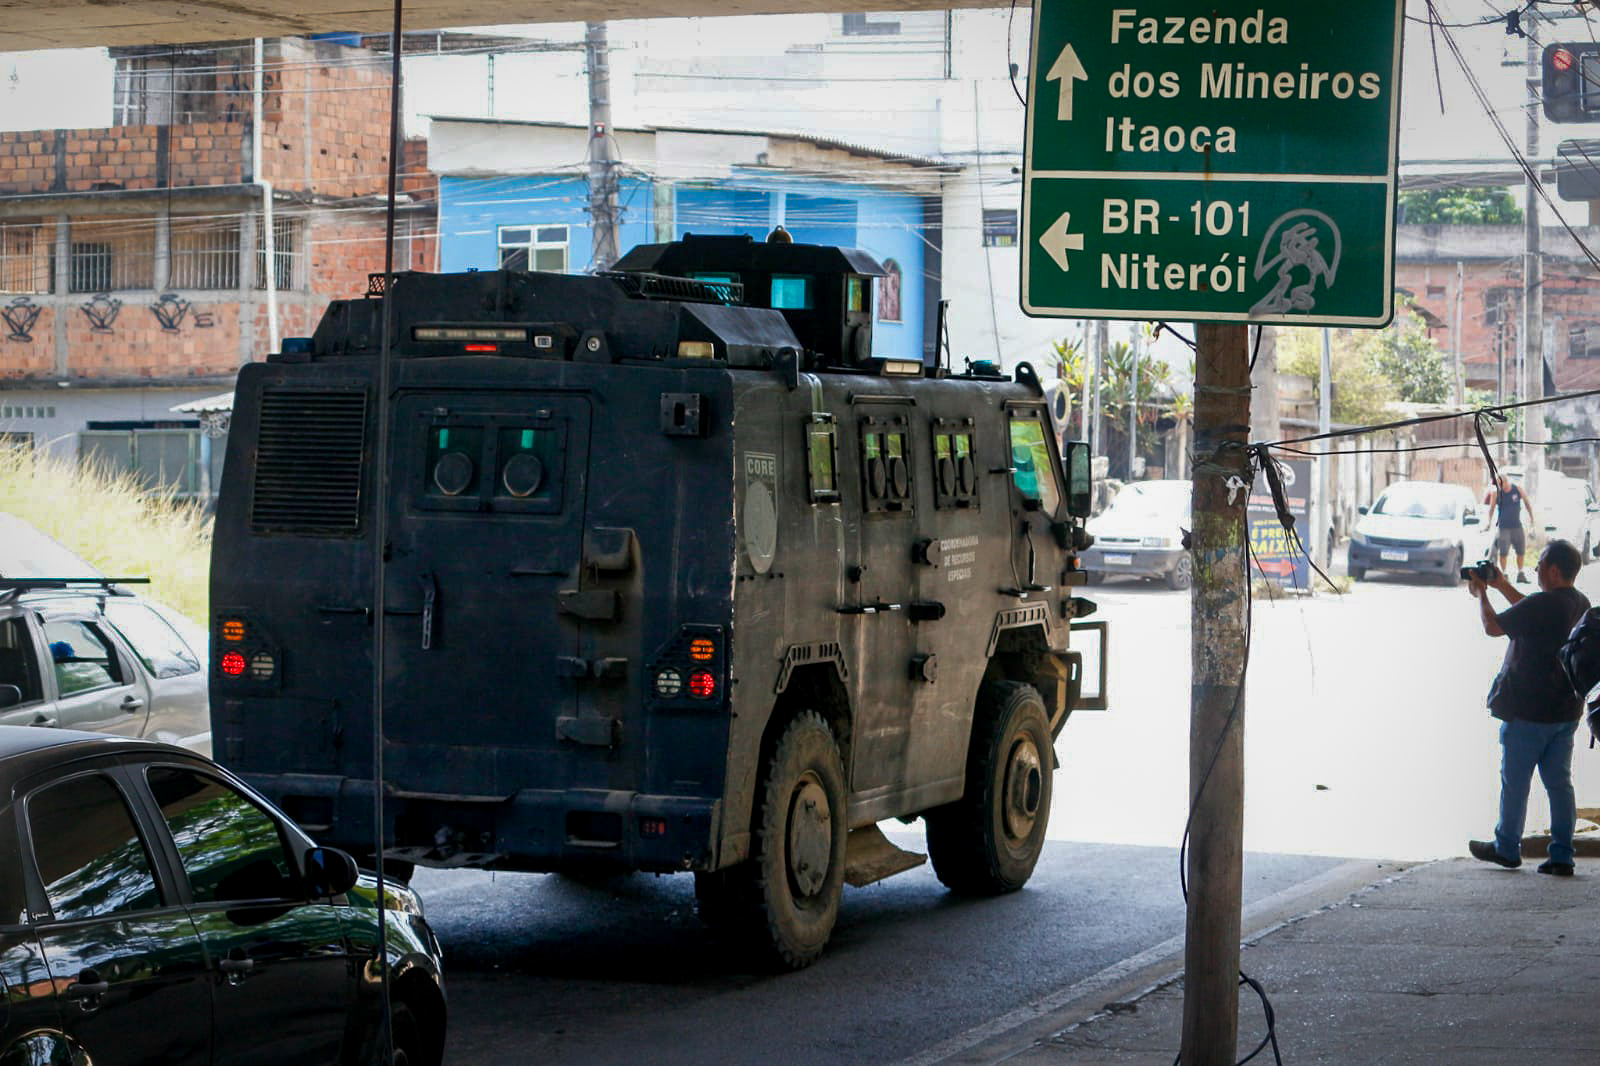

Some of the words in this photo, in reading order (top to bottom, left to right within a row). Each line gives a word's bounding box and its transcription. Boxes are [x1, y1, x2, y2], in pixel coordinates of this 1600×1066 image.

[1111, 9, 1288, 44] Fazenda
[1108, 63, 1180, 98] dos
[1200, 62, 1381, 99] Mineiros
[1105, 117, 1237, 153] Itaoca
[1101, 252, 1246, 293] Niterói
[747, 458, 775, 476] CORE
